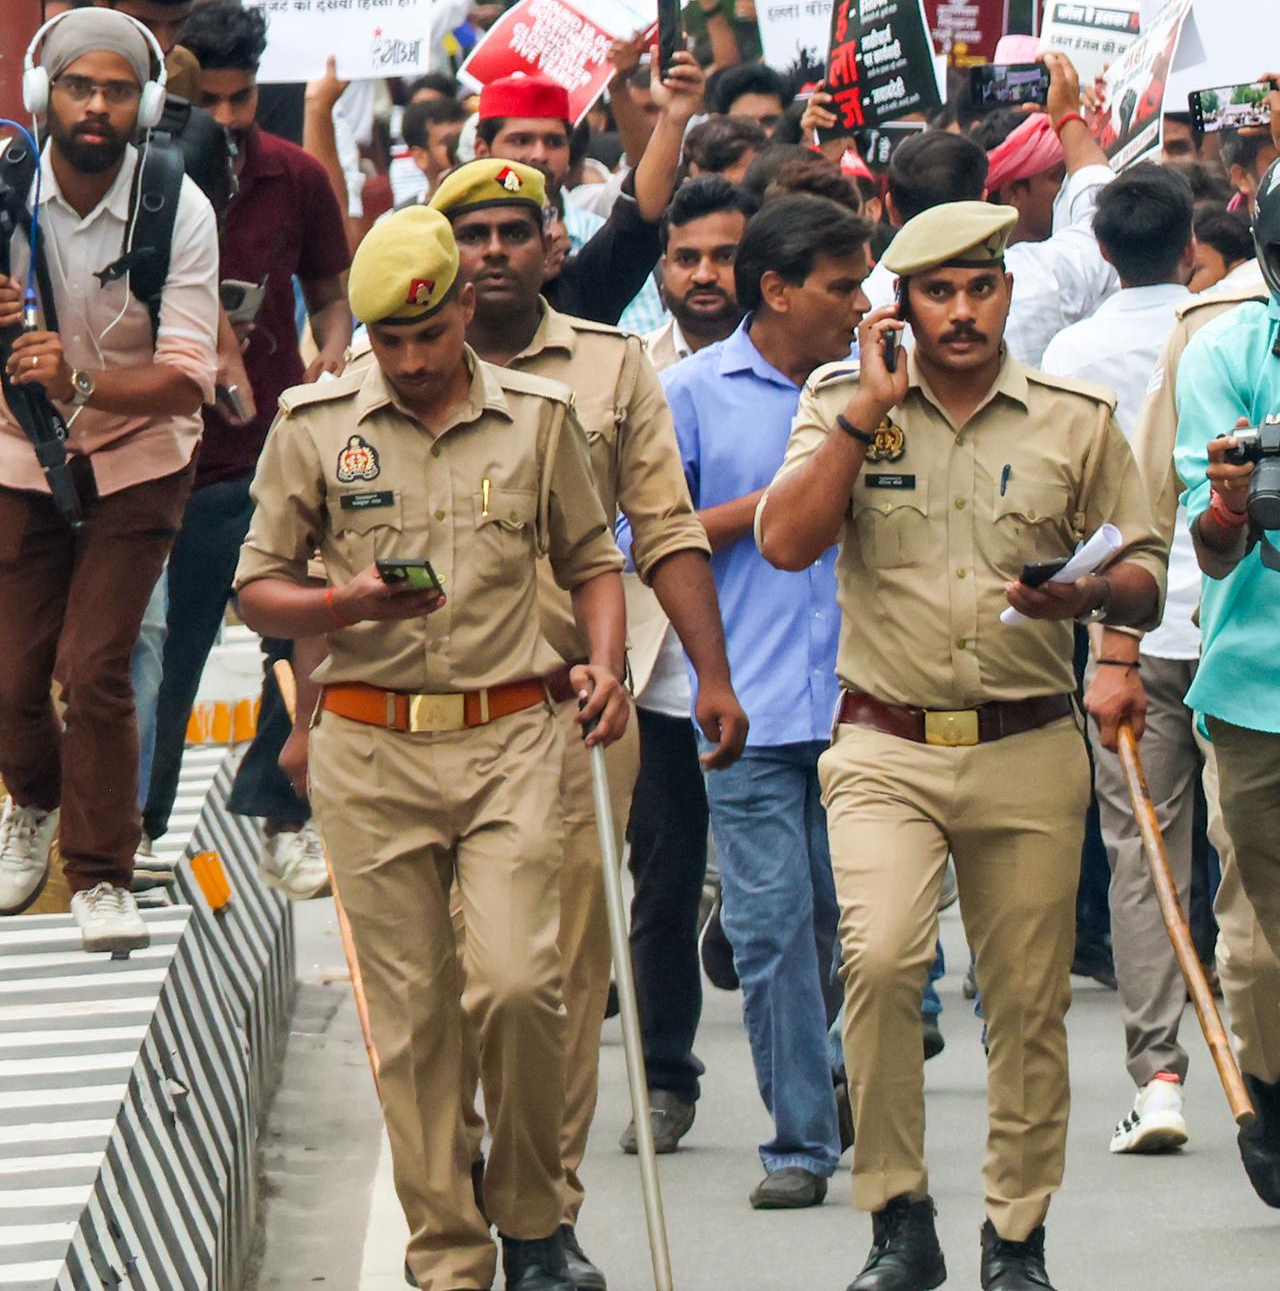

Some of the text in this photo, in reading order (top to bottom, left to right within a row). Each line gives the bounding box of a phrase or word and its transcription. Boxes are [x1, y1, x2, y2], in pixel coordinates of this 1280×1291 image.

[829, 39, 858, 88] ला
[1102, 38, 1116, 55] की
[834, 86, 865, 129] ज
